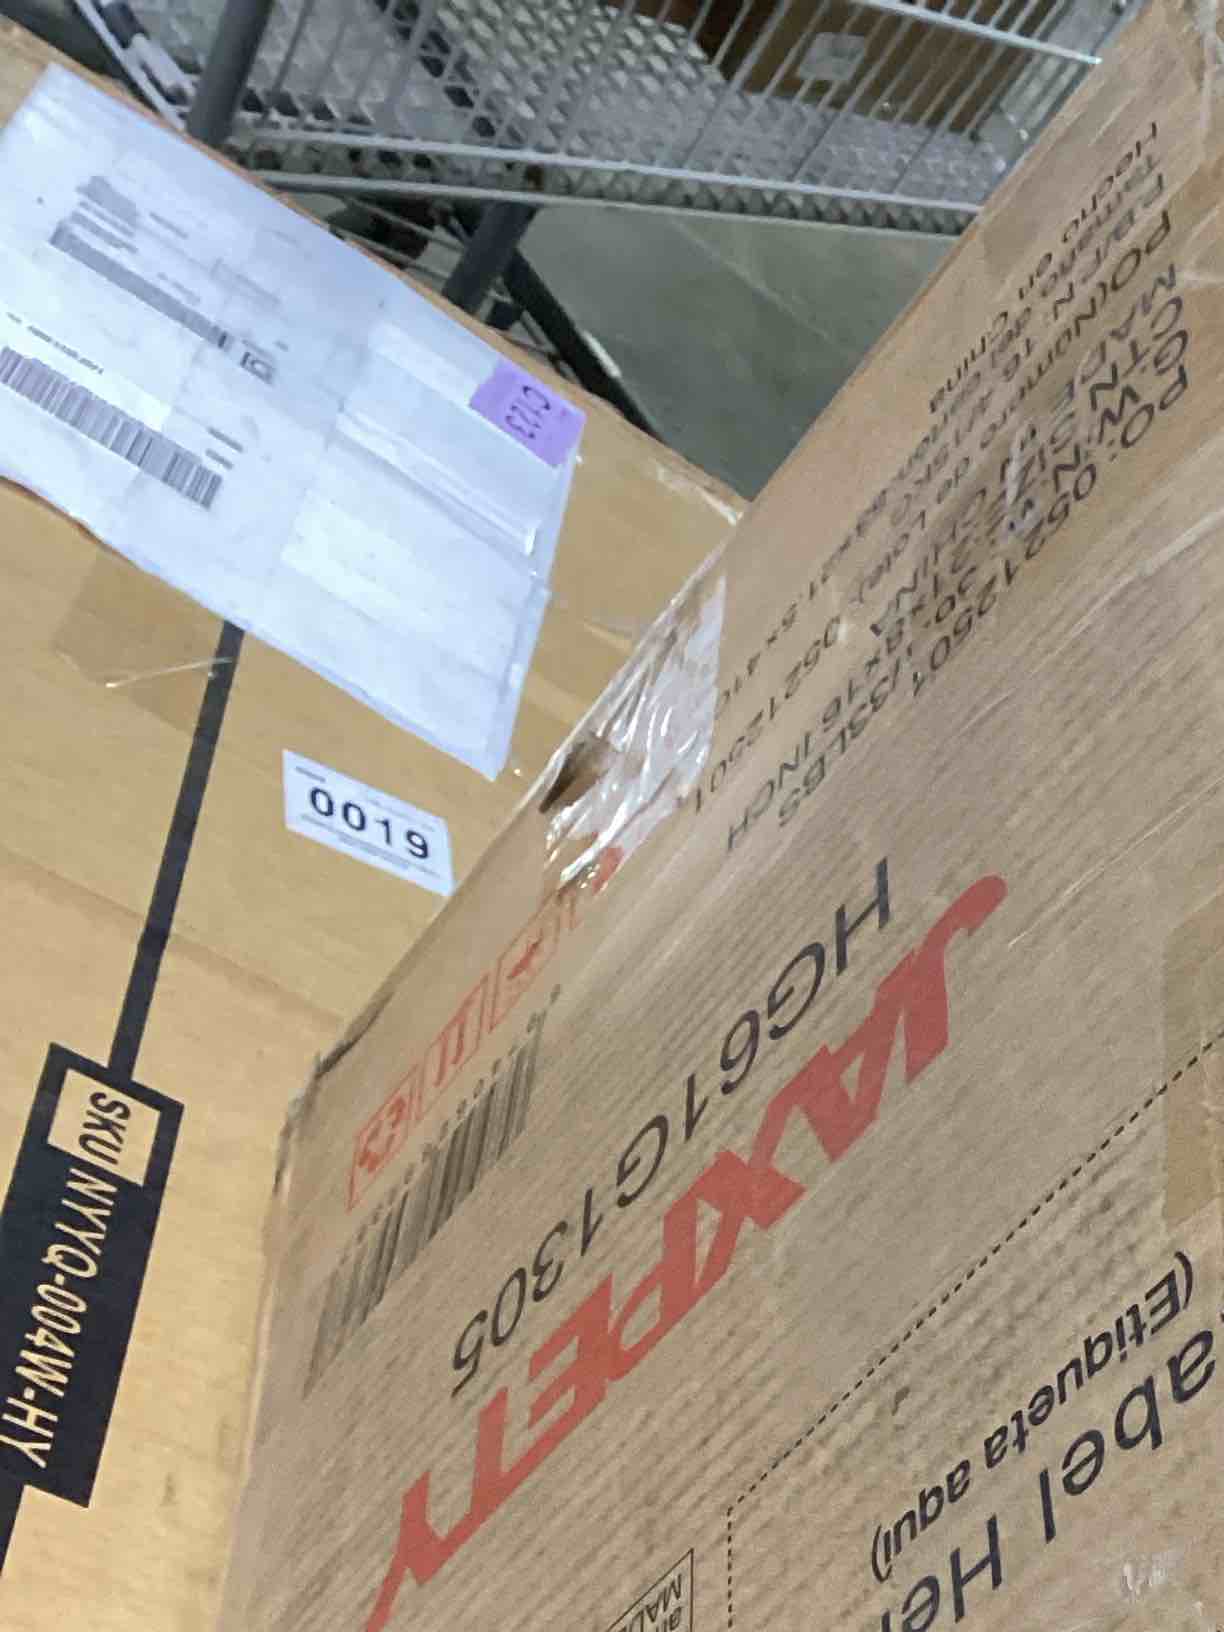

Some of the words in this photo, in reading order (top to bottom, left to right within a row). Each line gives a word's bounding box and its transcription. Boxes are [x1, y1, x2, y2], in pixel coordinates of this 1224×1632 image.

[928, 303, 1009, 417] China
[1048, 257, 1177, 425] MADE
[1088, 287, 1183, 415] CTN
[1105, 360, 1187, 470] PO:
[867, 482, 987, 646] CHINA
[309, 784, 433, 859] 0019
[723, 726, 813, 857] INCH
[75, 1089, 133, 1165] SKU
[451, 858, 891, 1398] HG61G1305
[0, 1168, 120, 1467] NYYQ-004W-HY
[979, 1247, 1196, 1479] (Etiqueta
[867, 1456, 968, 1584] aquí)
